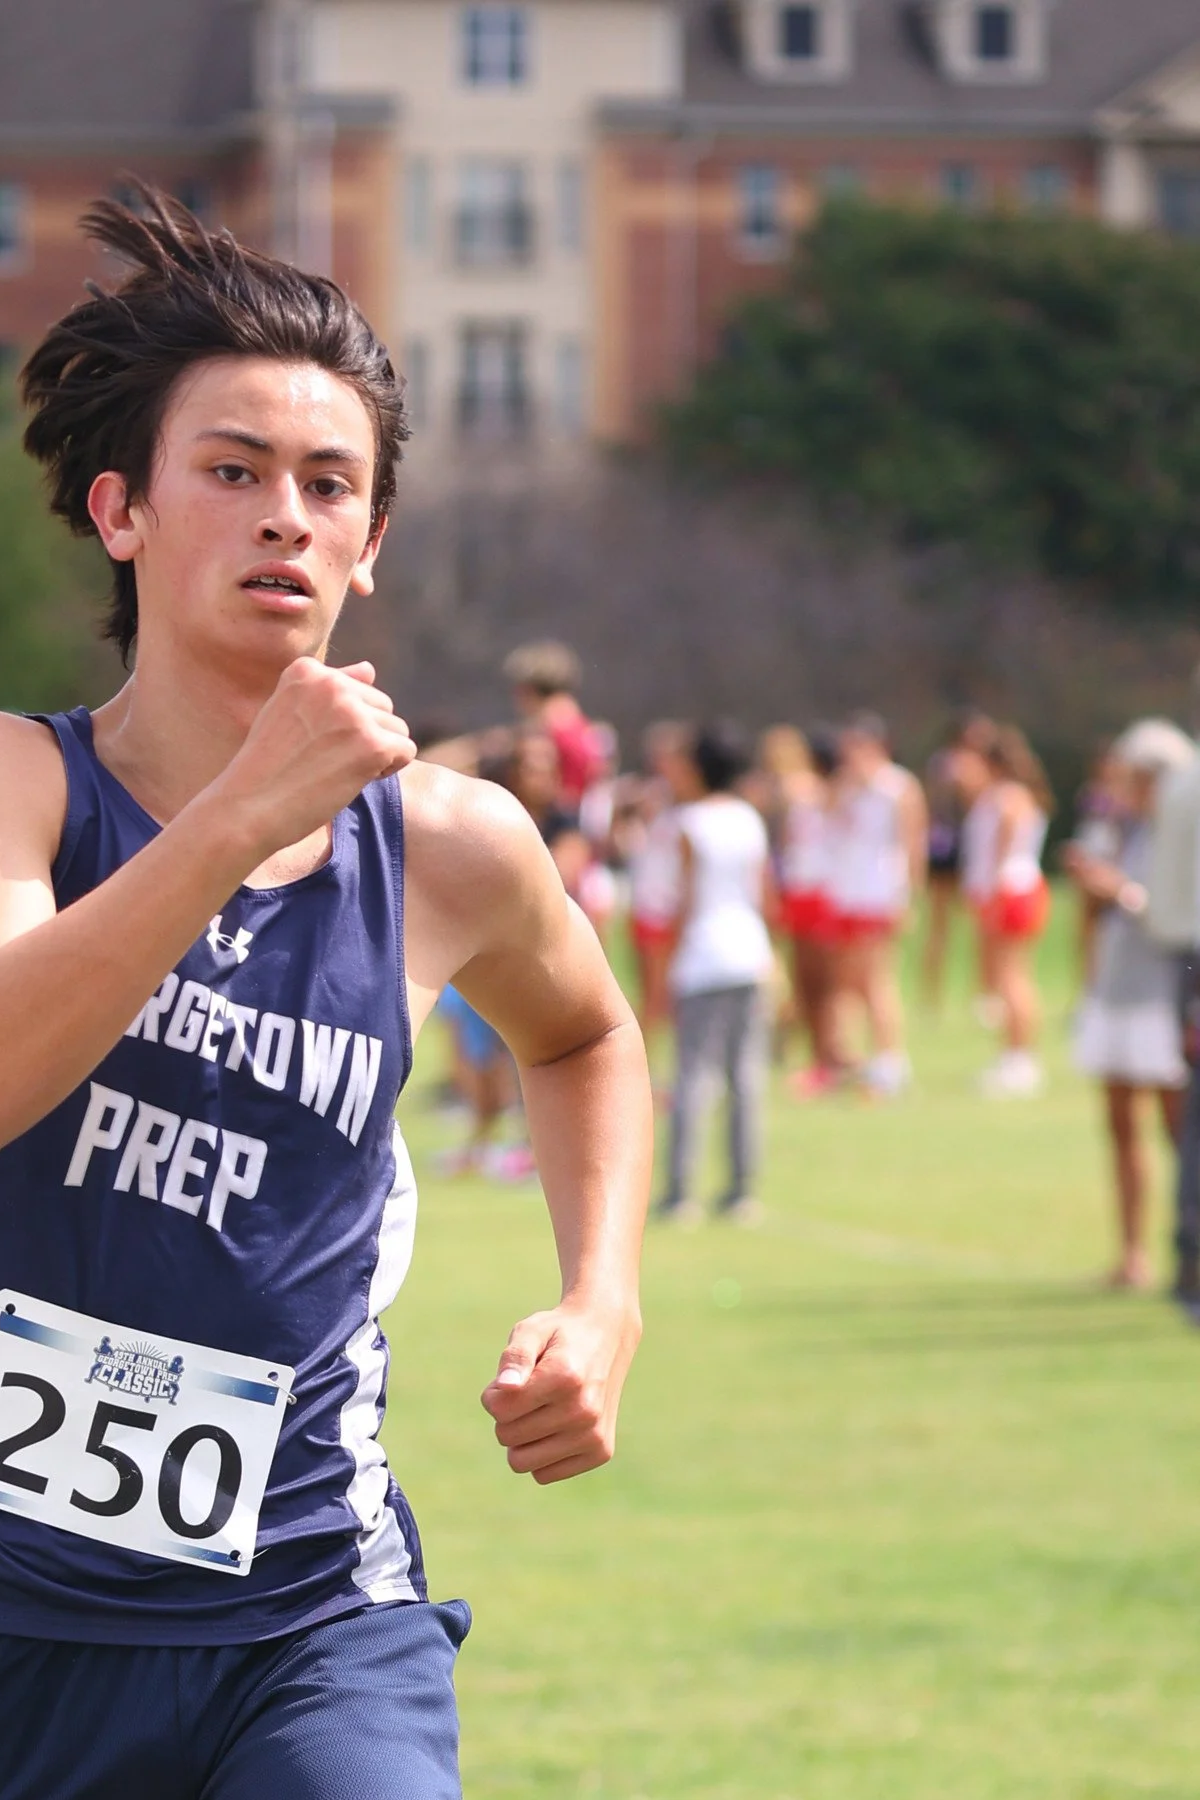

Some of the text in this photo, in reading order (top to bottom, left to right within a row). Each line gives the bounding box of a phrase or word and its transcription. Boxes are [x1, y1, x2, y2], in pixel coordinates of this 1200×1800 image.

[63, 1081, 268, 1233] PREP
[97, 1355, 179, 1382] GEORGETOWN PREP
[136, 1355, 168, 1372] ANNUAL
[97, 1364, 170, 1397] CLASSIC
